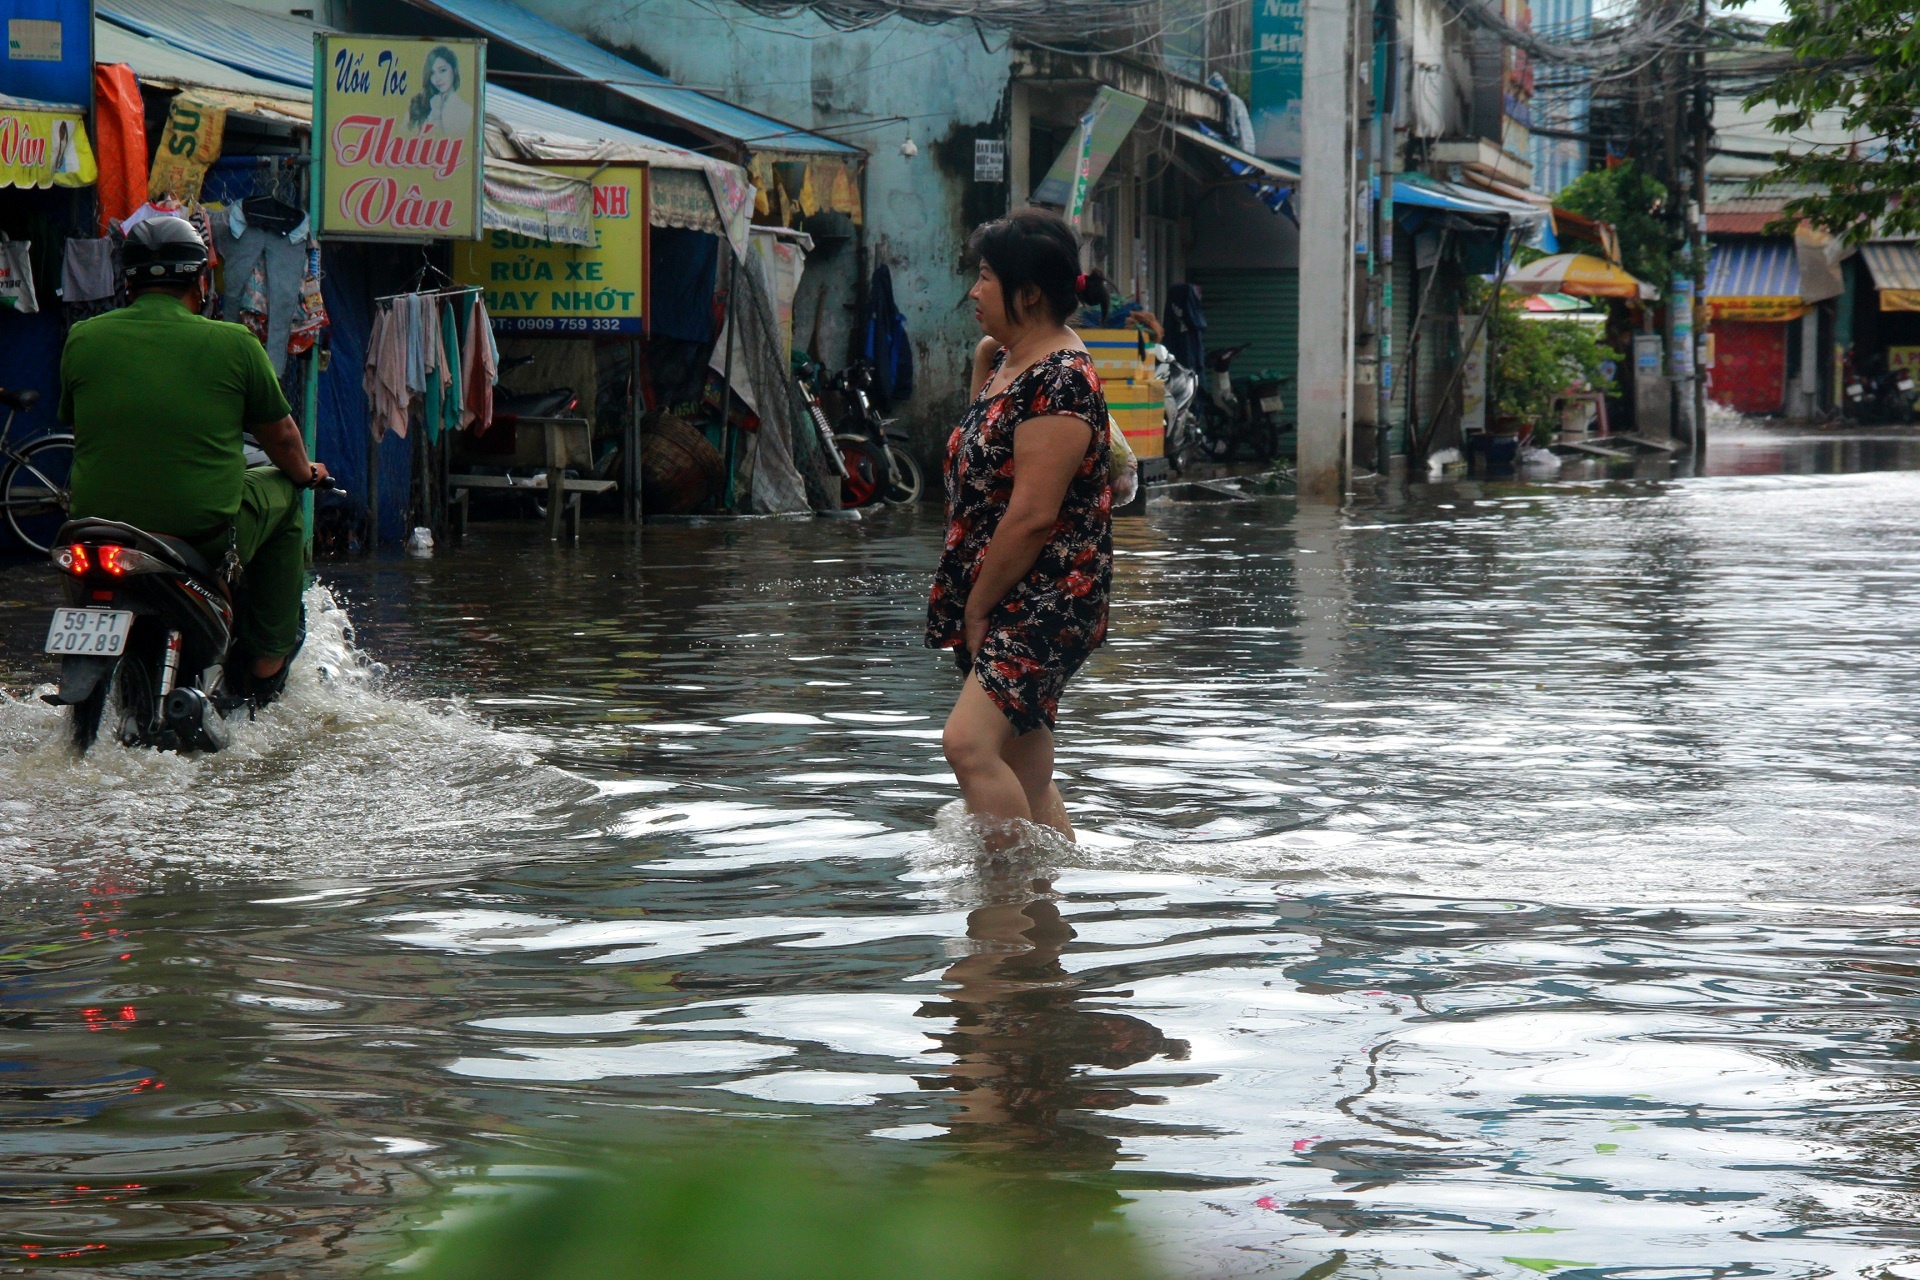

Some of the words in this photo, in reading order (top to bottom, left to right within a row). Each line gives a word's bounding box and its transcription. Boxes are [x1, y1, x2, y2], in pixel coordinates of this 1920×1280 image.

[378, 50, 408, 97] Tóc
[340, 176, 457, 231] Vân
[592, 184, 630, 219] NH
[565, 262, 603, 281] XE
[482, 291, 539, 311] HAY
[551, 286, 635, 311] NHỚT
[517, 319, 554, 331] 0909
[560, 319, 587, 331] 759
[592, 319, 620, 331] 332
[64, 612, 117, 632] 59-F1
[51, 632, 120, 652] 207.89
